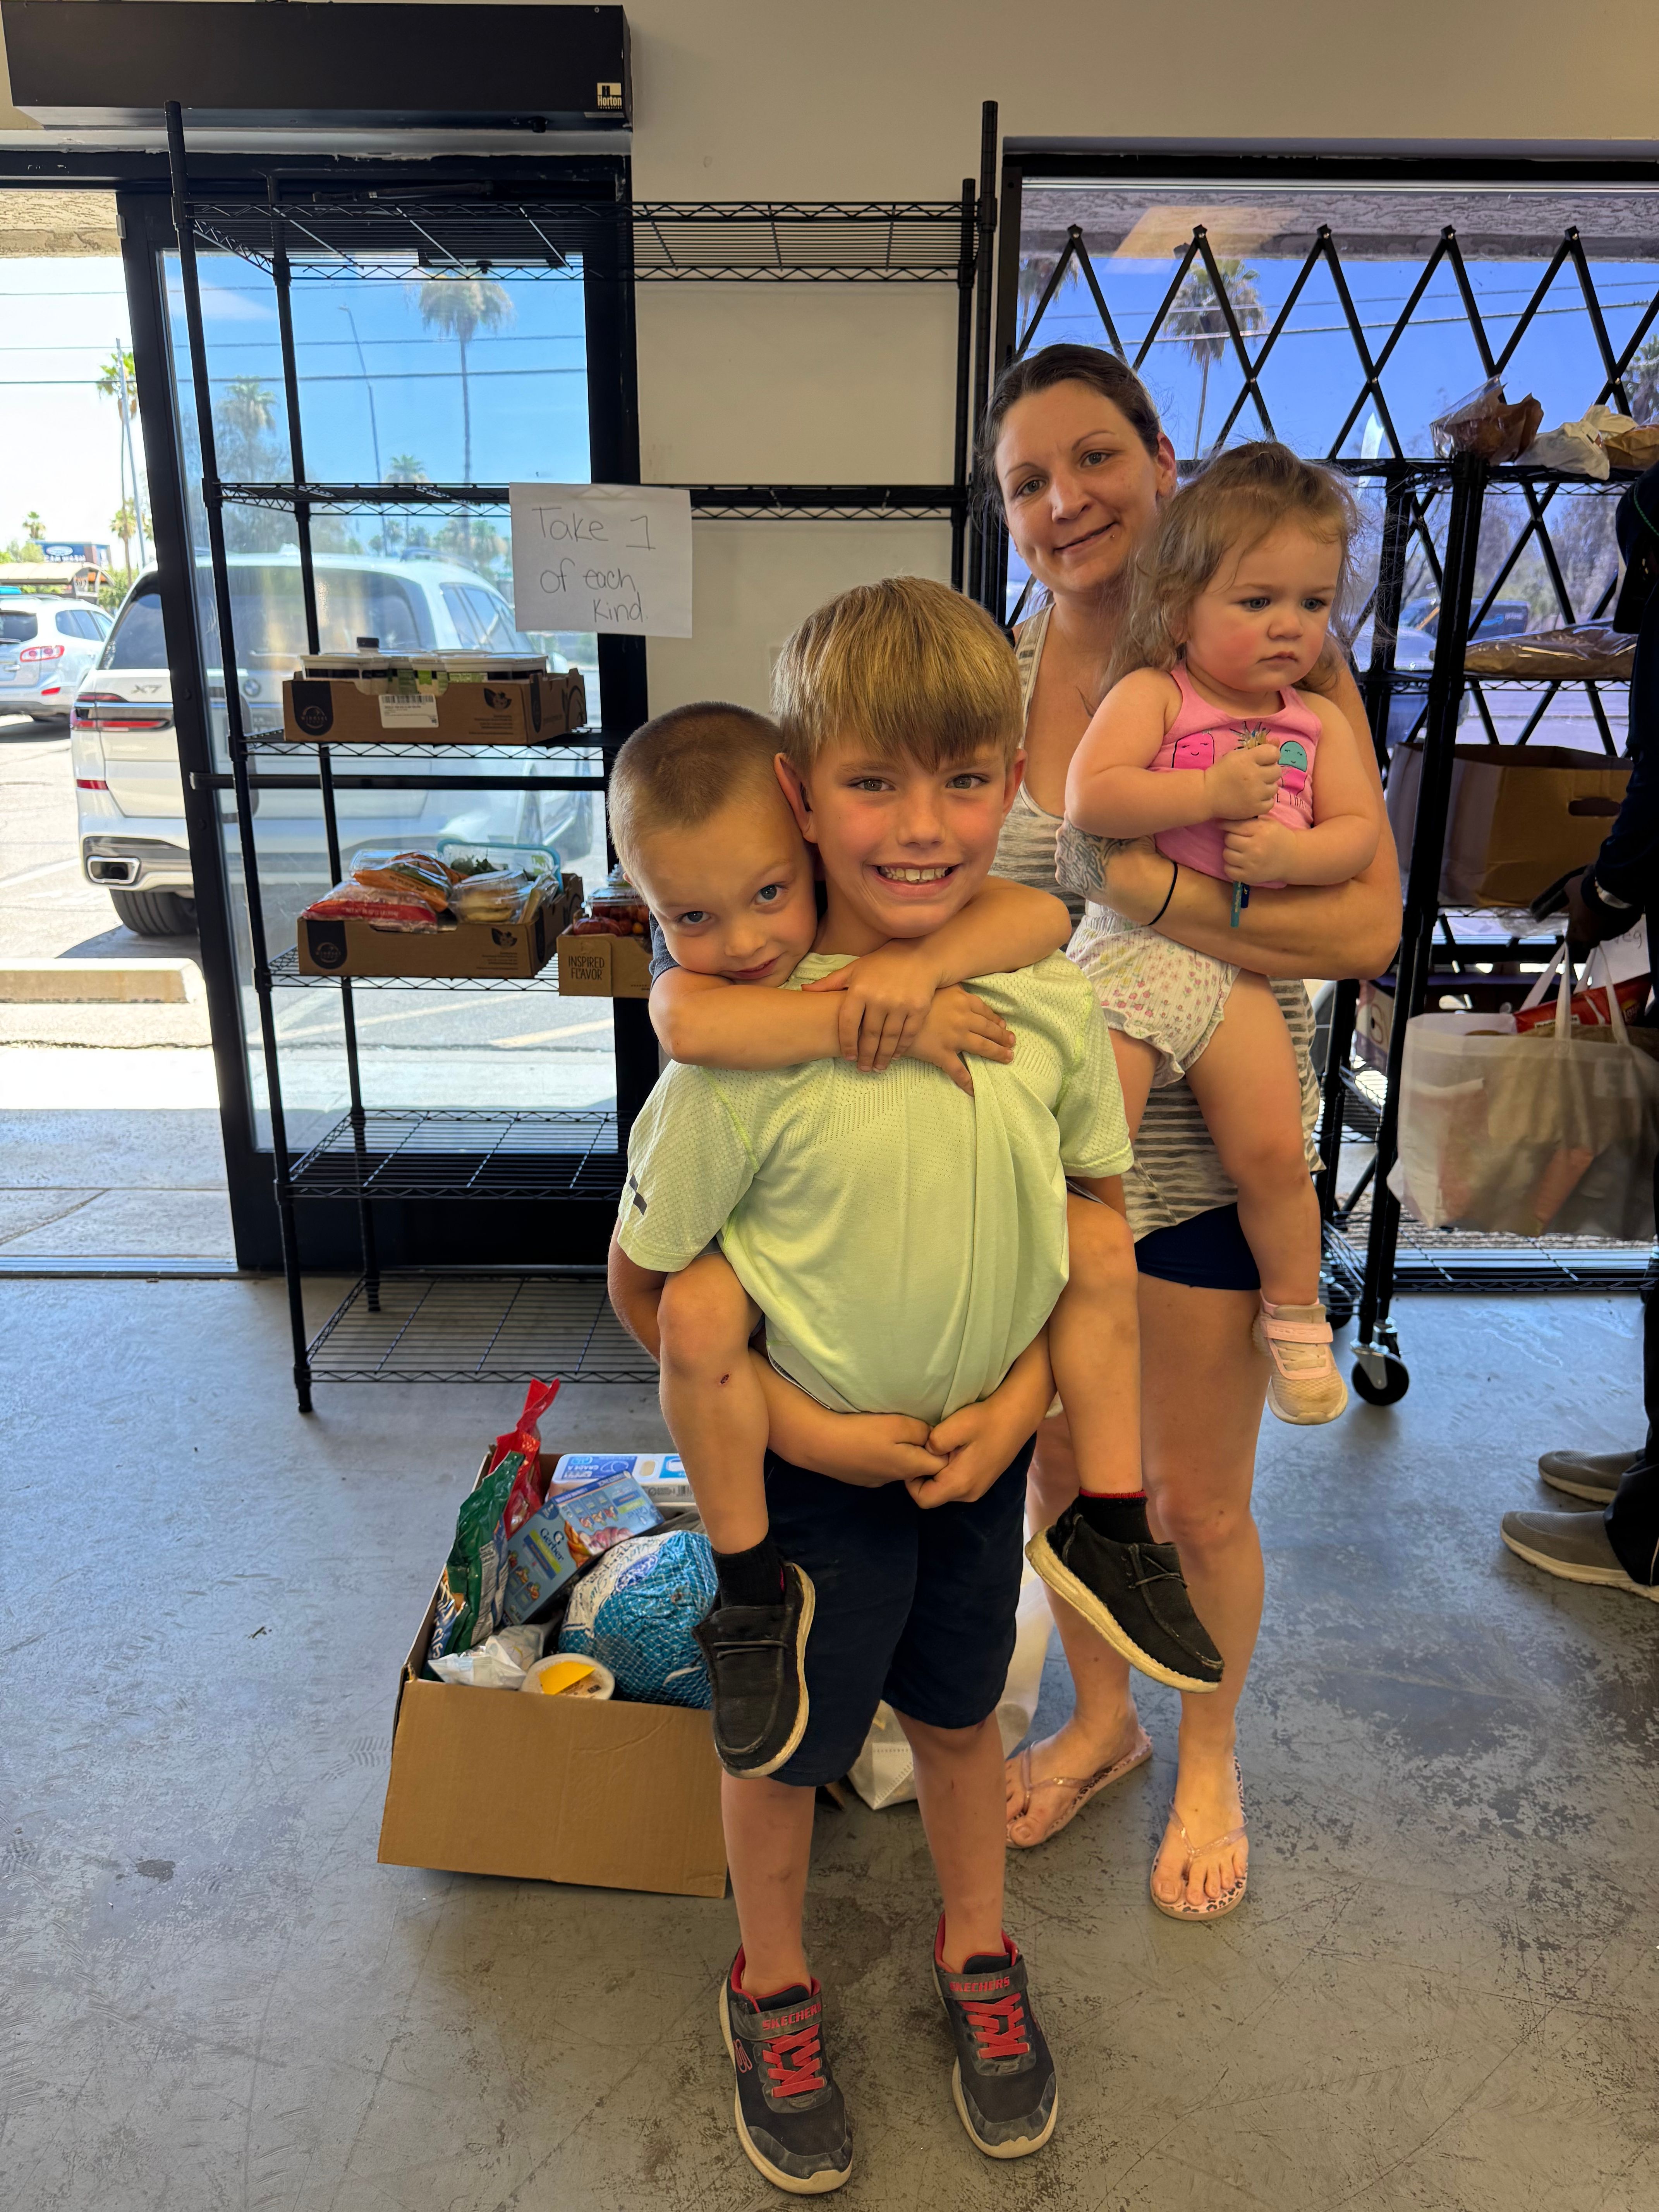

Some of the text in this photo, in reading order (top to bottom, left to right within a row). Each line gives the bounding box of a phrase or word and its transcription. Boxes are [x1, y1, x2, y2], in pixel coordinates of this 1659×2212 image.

[597, 95, 622, 106] Horton
[532, 507, 656, 550] Take 1
[583, 568, 636, 592] each
[131, 684, 162, 694] X7
[568, 956, 605, 969] INSPIRED
[571, 967, 603, 981] FLAVOR
[540, 1528, 564, 1561] Gerber
[949, 1976, 1010, 1992] SKECHERS
[762, 2002, 822, 2032] SKECHERS
